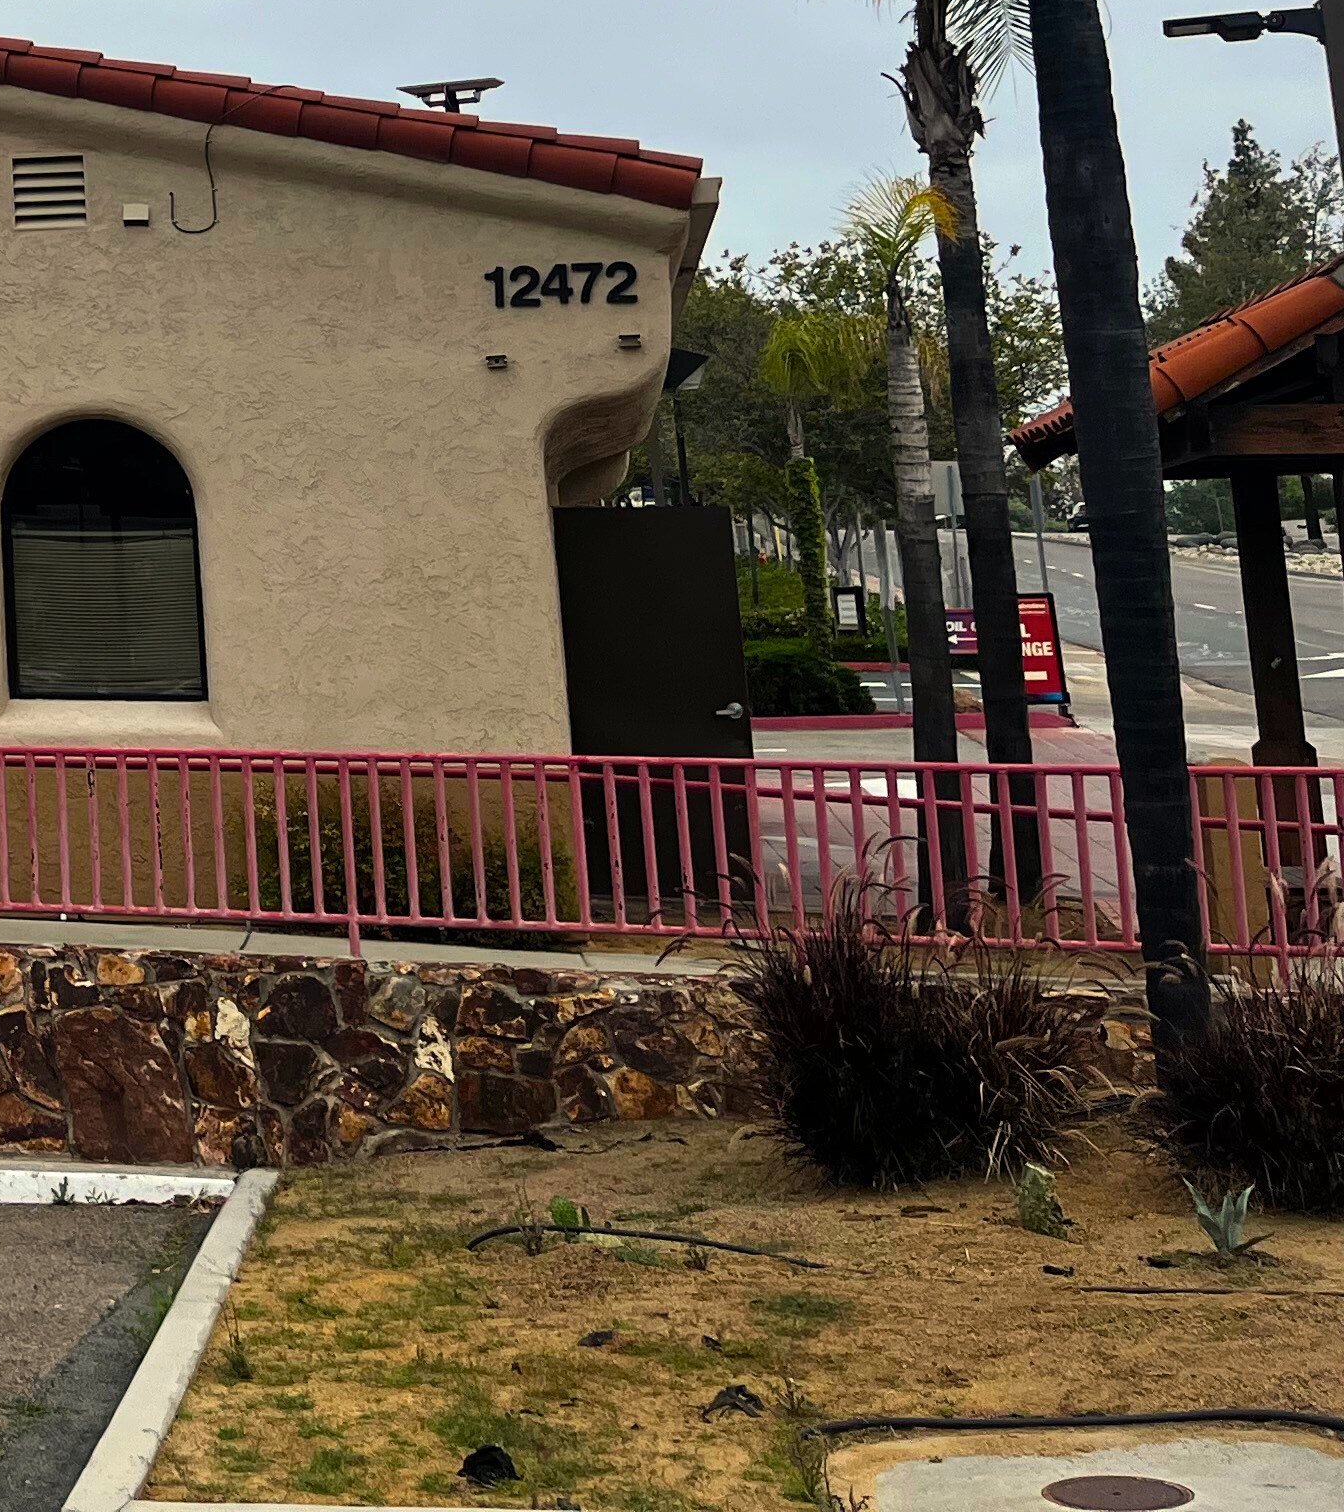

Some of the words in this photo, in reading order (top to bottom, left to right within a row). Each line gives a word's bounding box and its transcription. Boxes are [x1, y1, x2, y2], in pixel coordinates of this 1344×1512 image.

[484, 261, 638, 308] 12472
[946, 621, 967, 632] OIL
[1021, 641, 1054, 657] NGE
